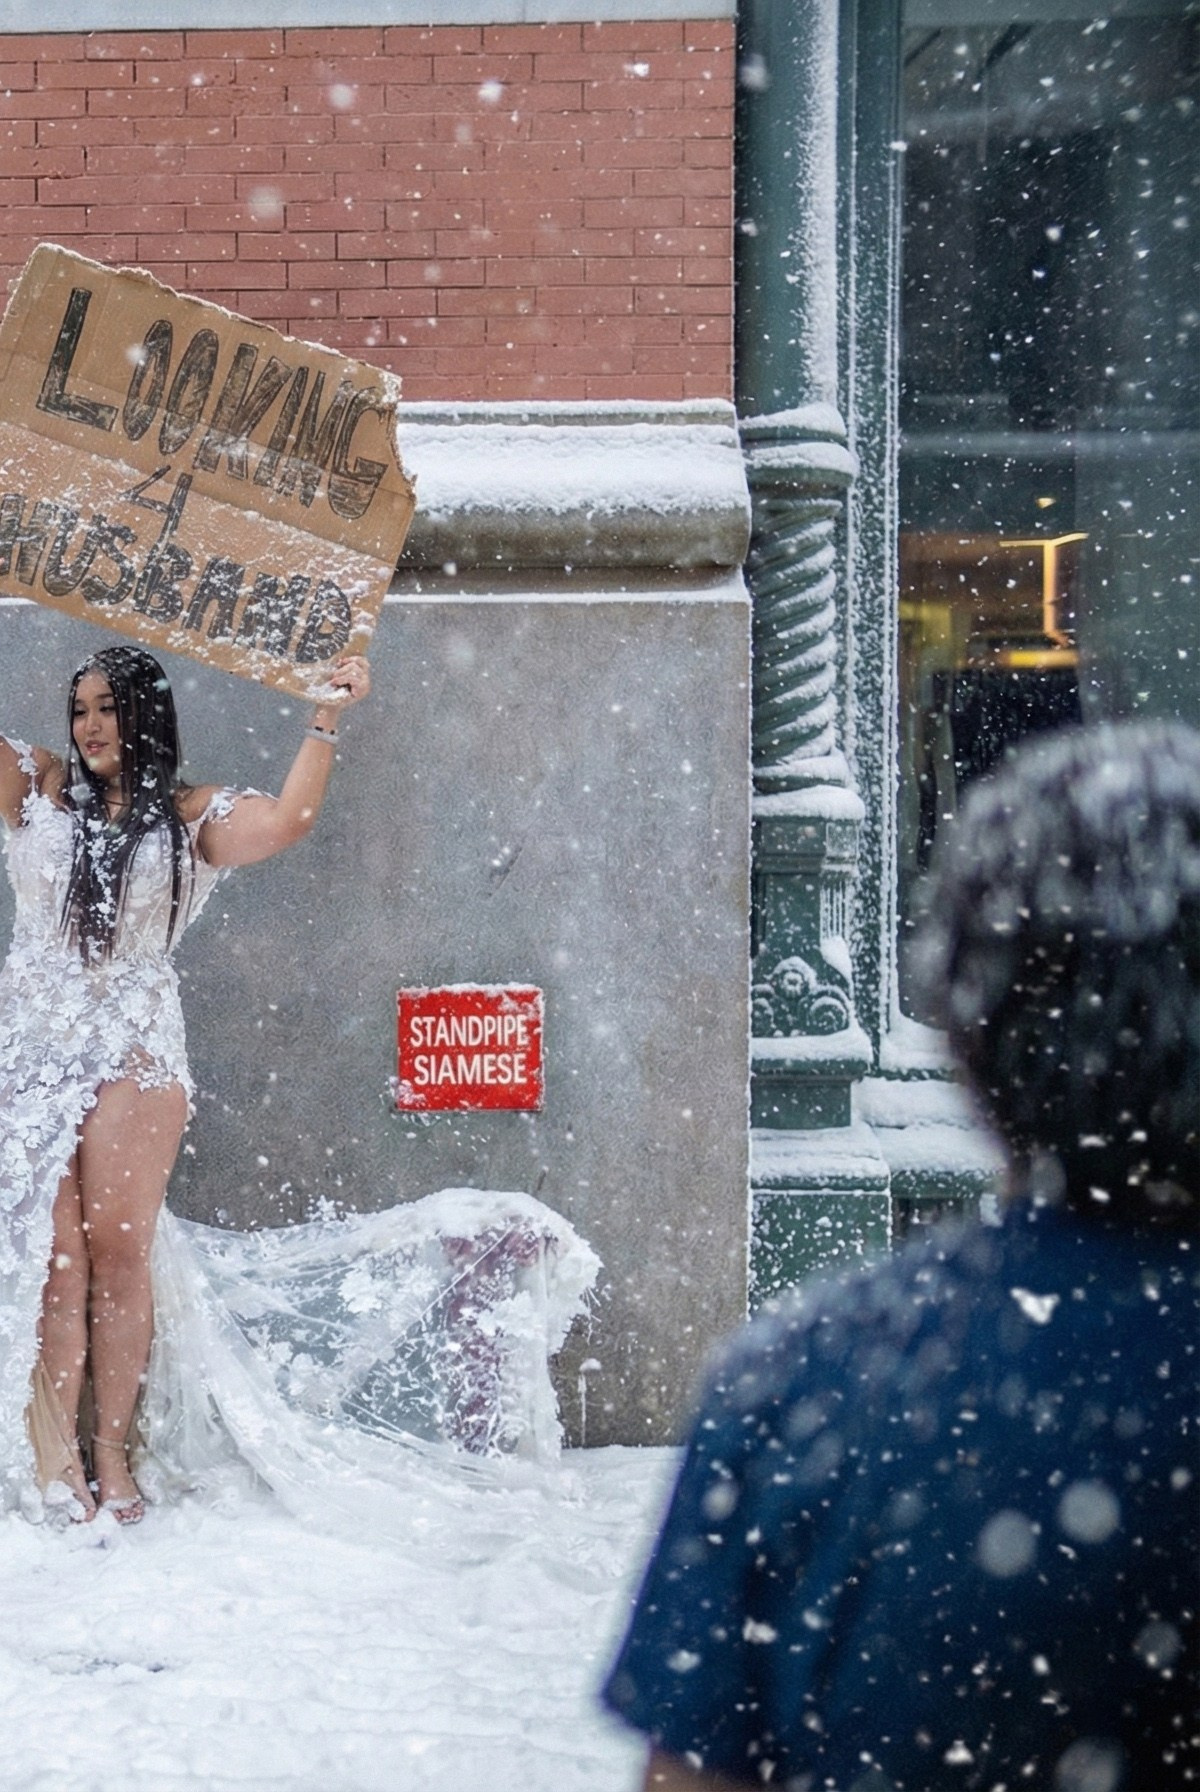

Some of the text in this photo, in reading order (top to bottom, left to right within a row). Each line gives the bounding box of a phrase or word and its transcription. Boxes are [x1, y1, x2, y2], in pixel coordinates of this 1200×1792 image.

[35, 287, 389, 520] LOOKING
[124, 464, 193, 551] 4
[410, 1014, 529, 1047] STANDPIPE
[414, 1053, 528, 1085] SIAMESE
